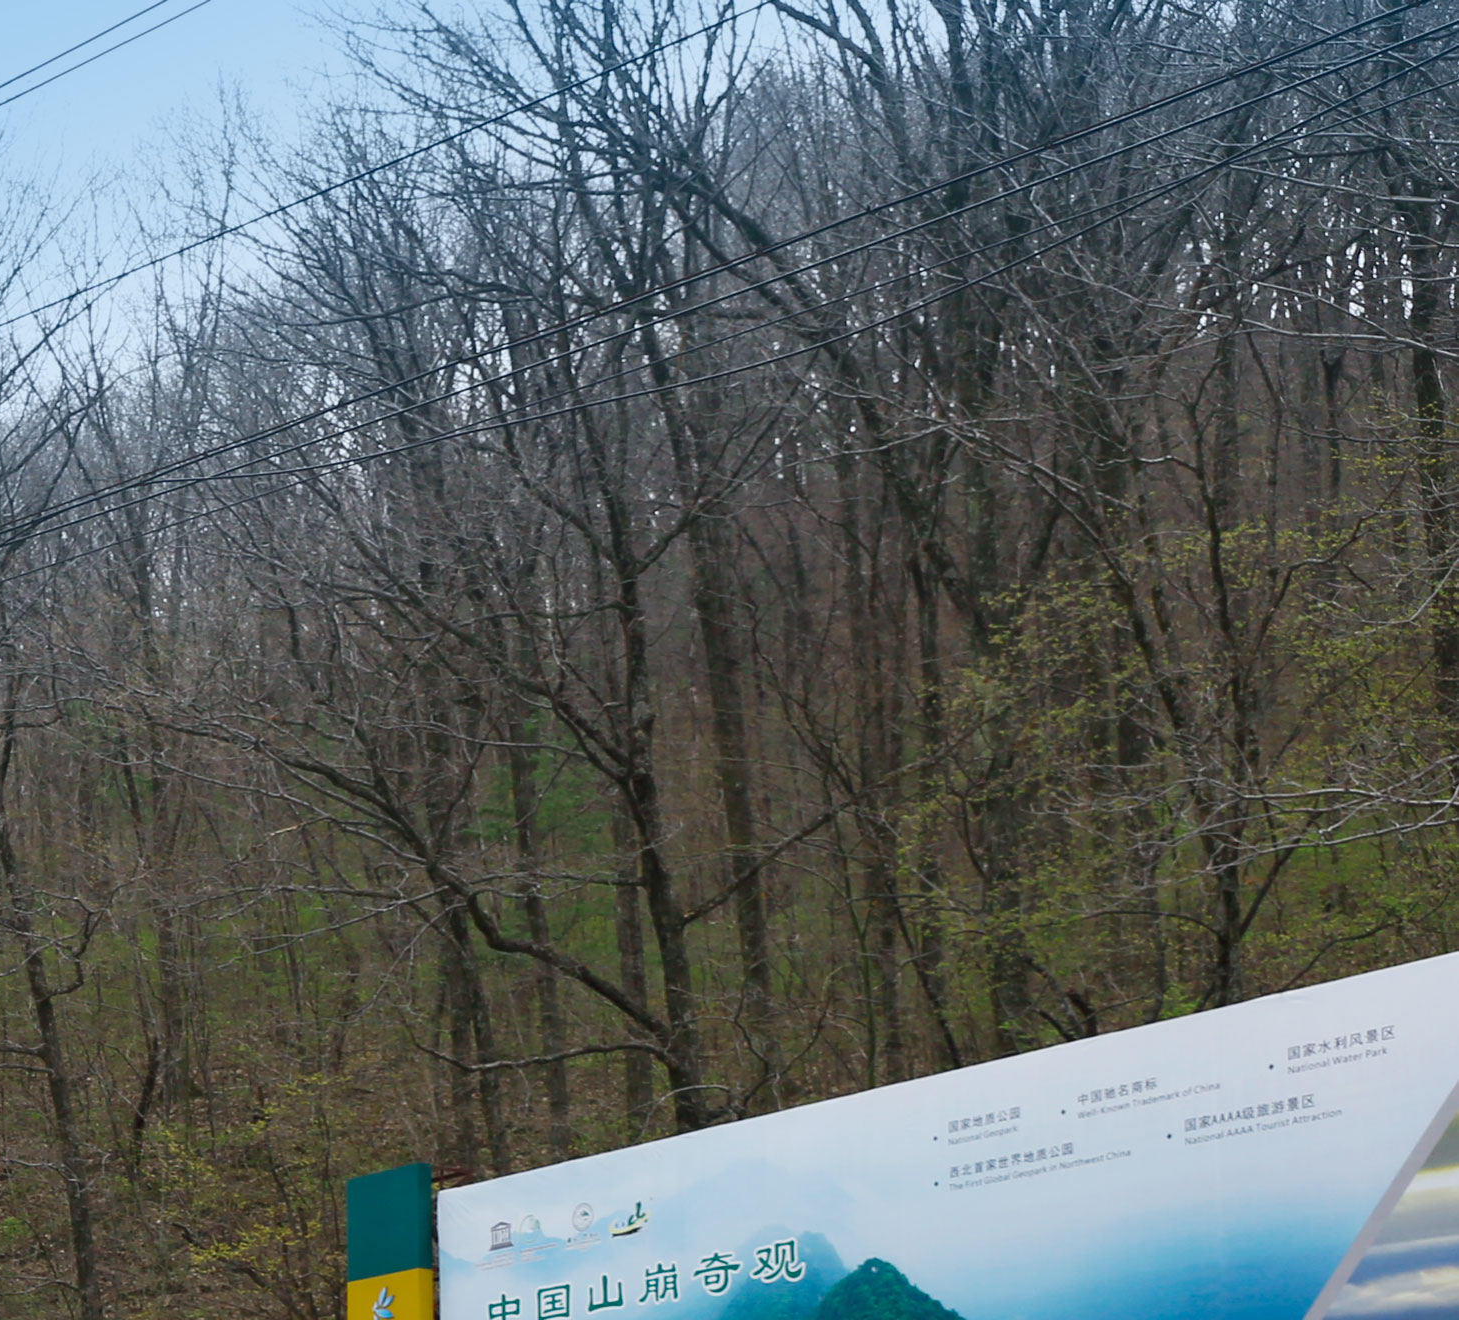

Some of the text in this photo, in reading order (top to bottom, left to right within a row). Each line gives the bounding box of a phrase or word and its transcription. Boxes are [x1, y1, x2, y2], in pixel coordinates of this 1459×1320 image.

[1287, 1025, 1396, 1061] 国家水利风景区
[1287, 1046, 1388, 1074] National Water Park
[1193, 1082, 1220, 1095] China
[948, 1106, 1021, 1133] 国家地质公园
[1184, 1093, 1315, 1132] 国家AAAA级旅游景区
[1184, 1129, 1225, 1146] National
[1256, 1117, 1290, 1132] Tourist
[1291, 1108, 1343, 1125] Attraction
[1106, 1148, 1131, 1160] China
